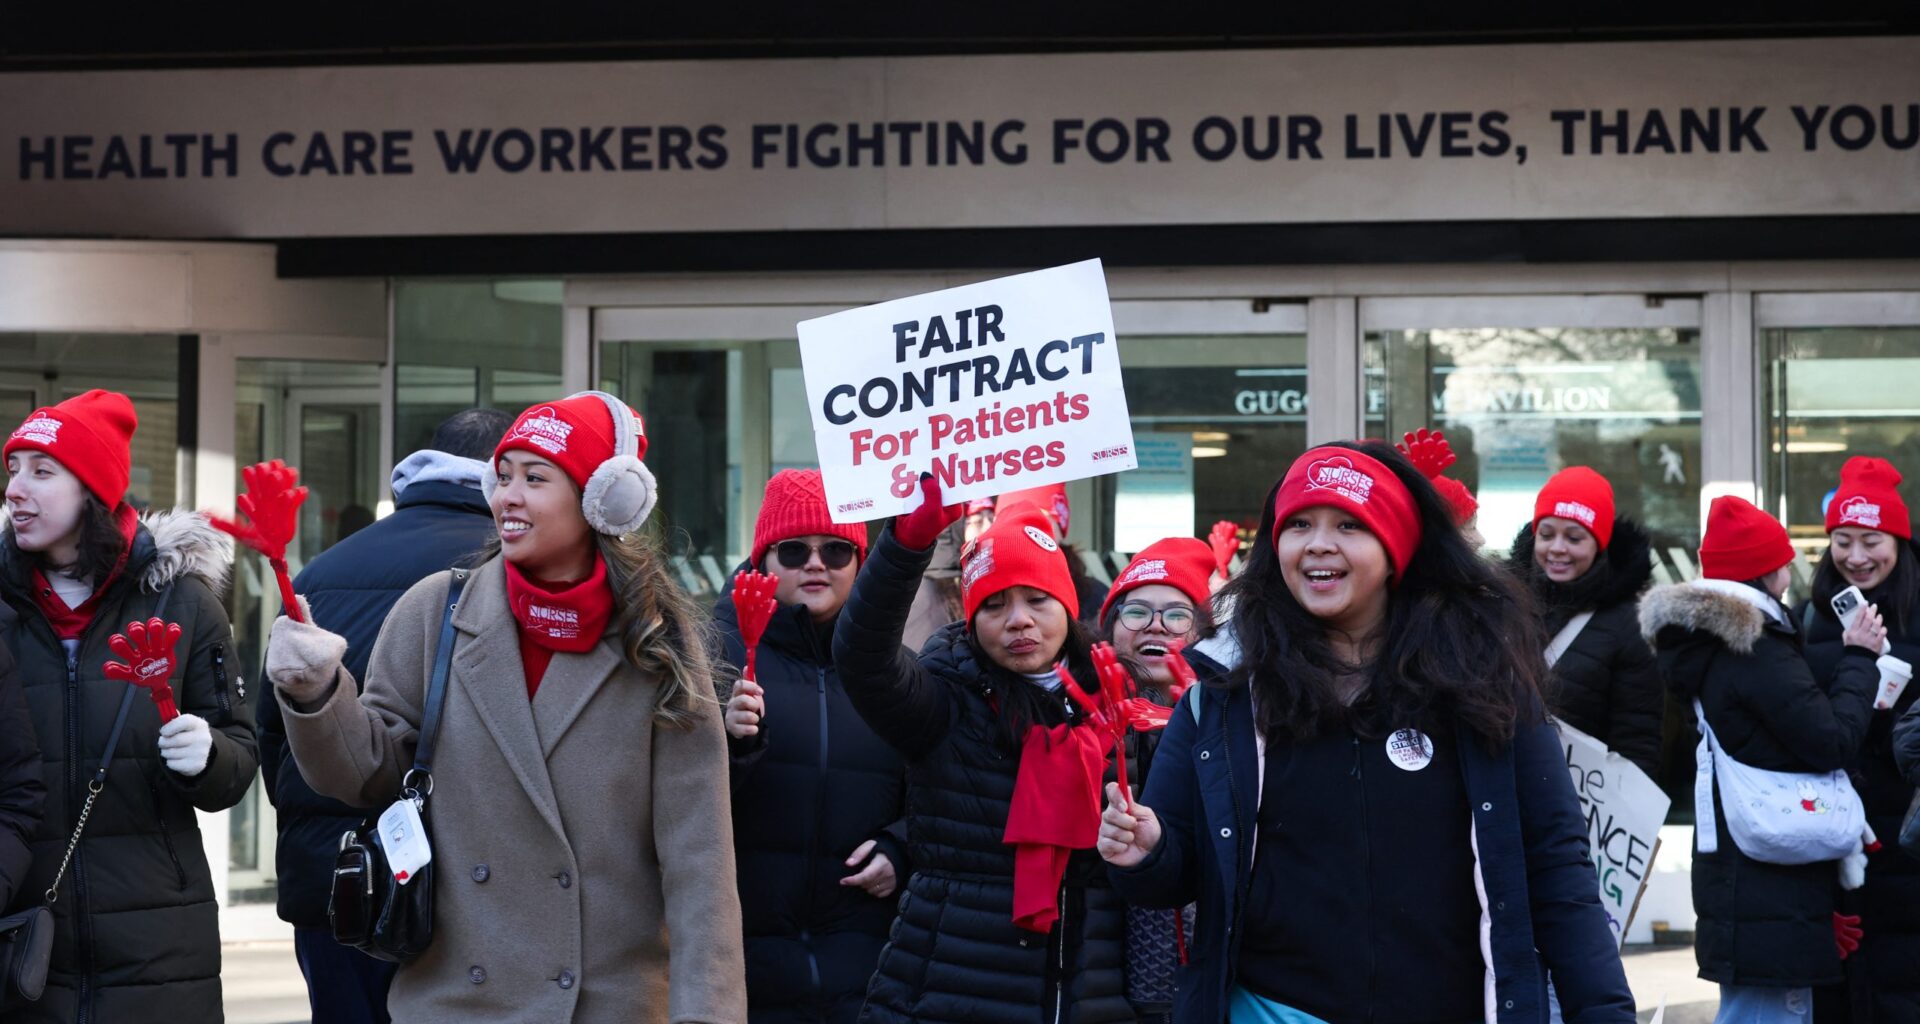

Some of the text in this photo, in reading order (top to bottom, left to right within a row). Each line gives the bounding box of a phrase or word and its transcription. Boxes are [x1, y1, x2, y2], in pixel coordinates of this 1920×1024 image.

[19, 103, 1920, 182] HEALTH CARE WORKERS FIGHTING FOR OUR LIVES, THANK YOU
[892, 304, 1006, 364] FAIR
[822, 331, 1106, 426] CONTRACT
[1465, 386, 1611, 413] AVILION
[849, 391, 1090, 466] For Patients
[1092, 446, 1128, 461] NURSES
[890, 440, 1066, 499] & Nurses
[1319, 466, 1373, 490] NURSES
[837, 499, 874, 513] NURSES
[529, 604, 579, 623] NURSES
[1567, 744, 1605, 804] he
